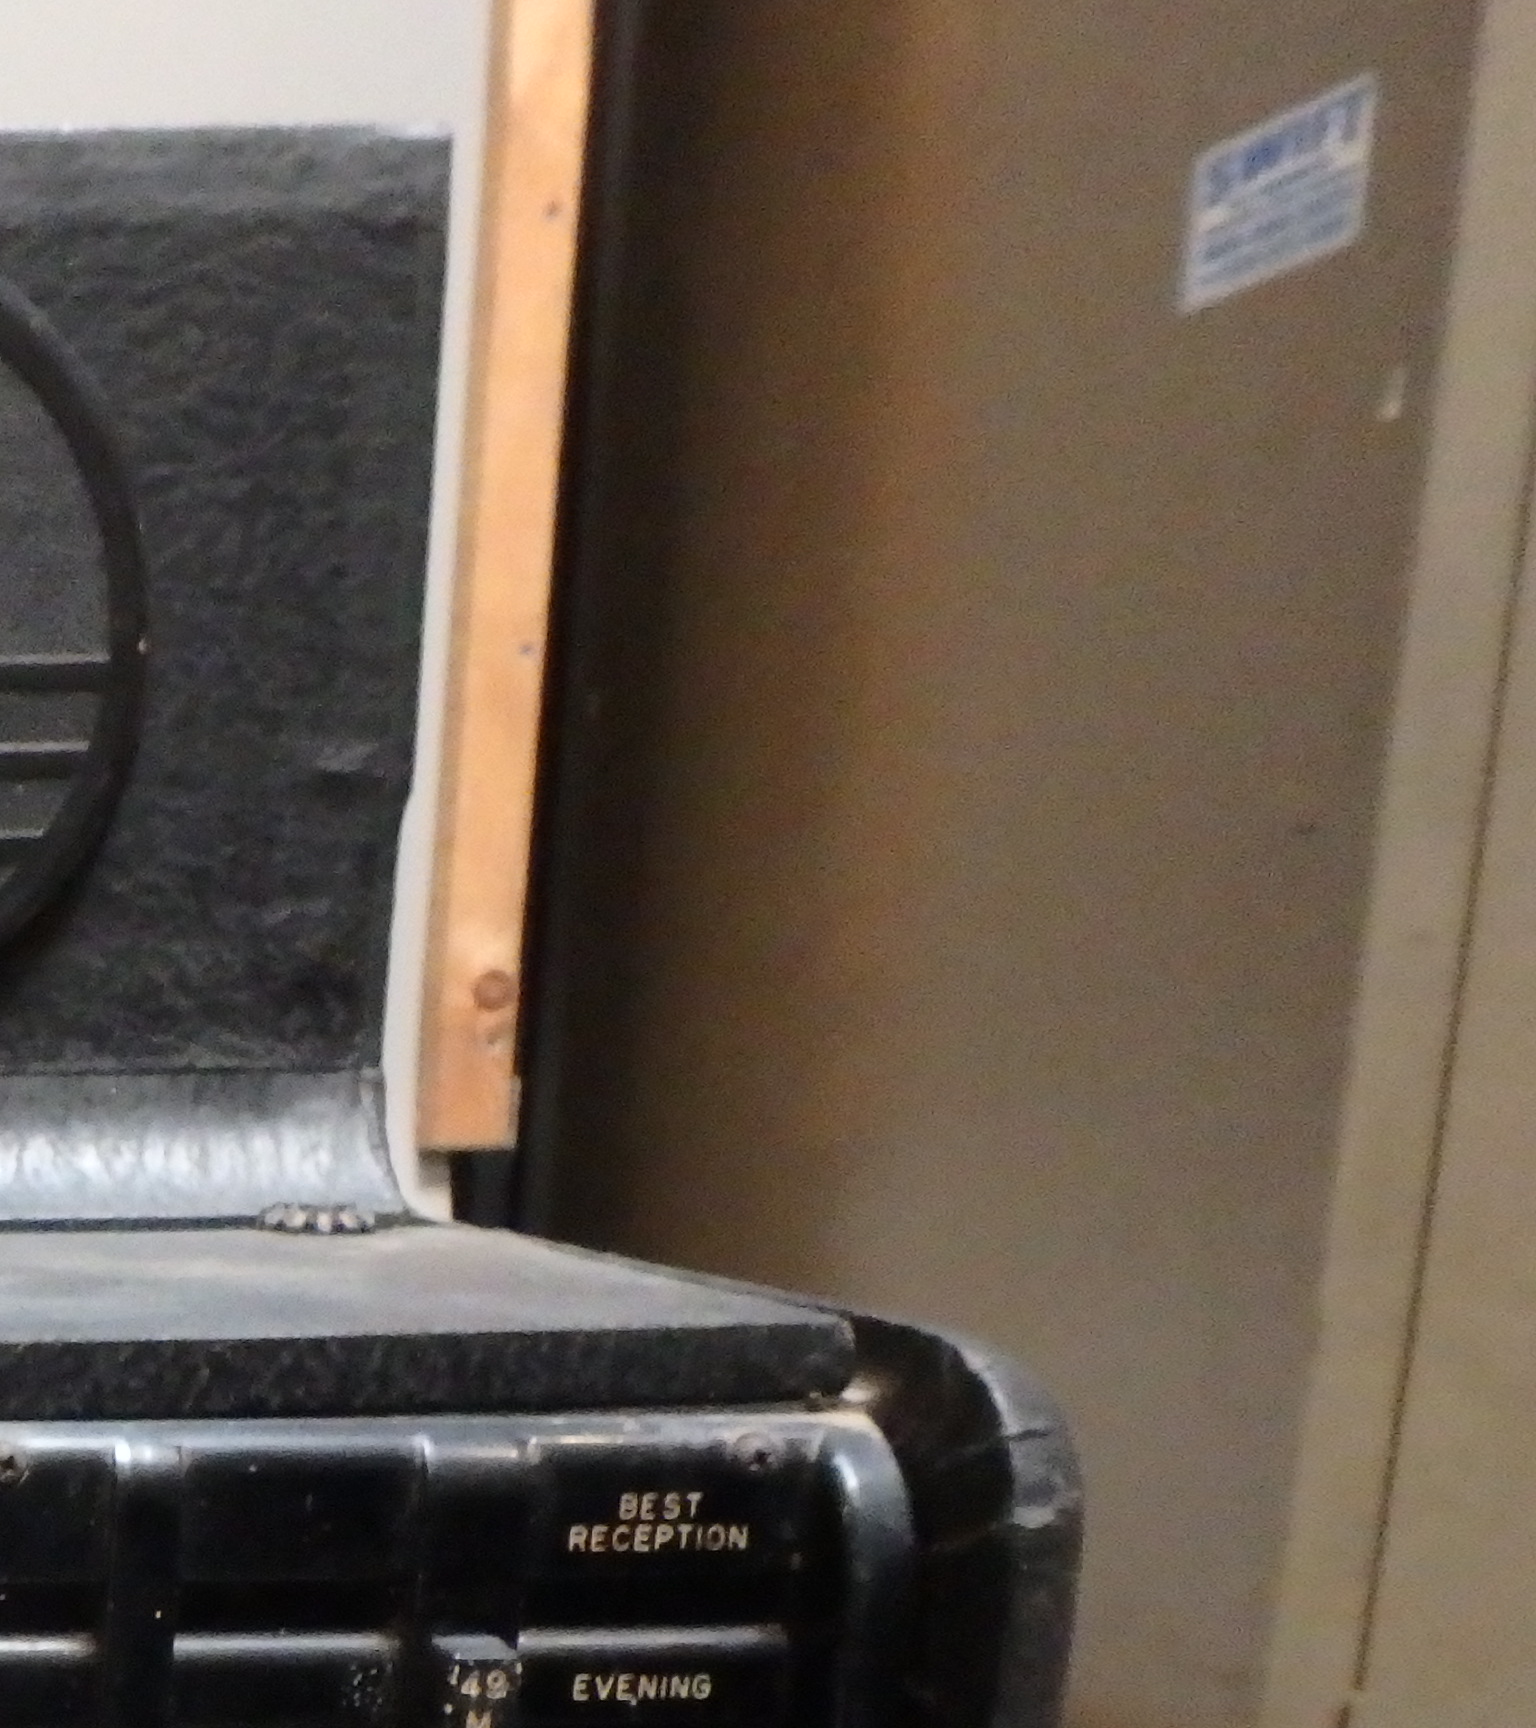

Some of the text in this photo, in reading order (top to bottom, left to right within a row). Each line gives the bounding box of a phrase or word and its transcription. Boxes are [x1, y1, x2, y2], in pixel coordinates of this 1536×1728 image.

[618, 1492, 704, 1520] BEST
[568, 1524, 749, 1552] RECEPTION
[460, 1669, 510, 1699] 49
[571, 1673, 713, 1702] EVENING
